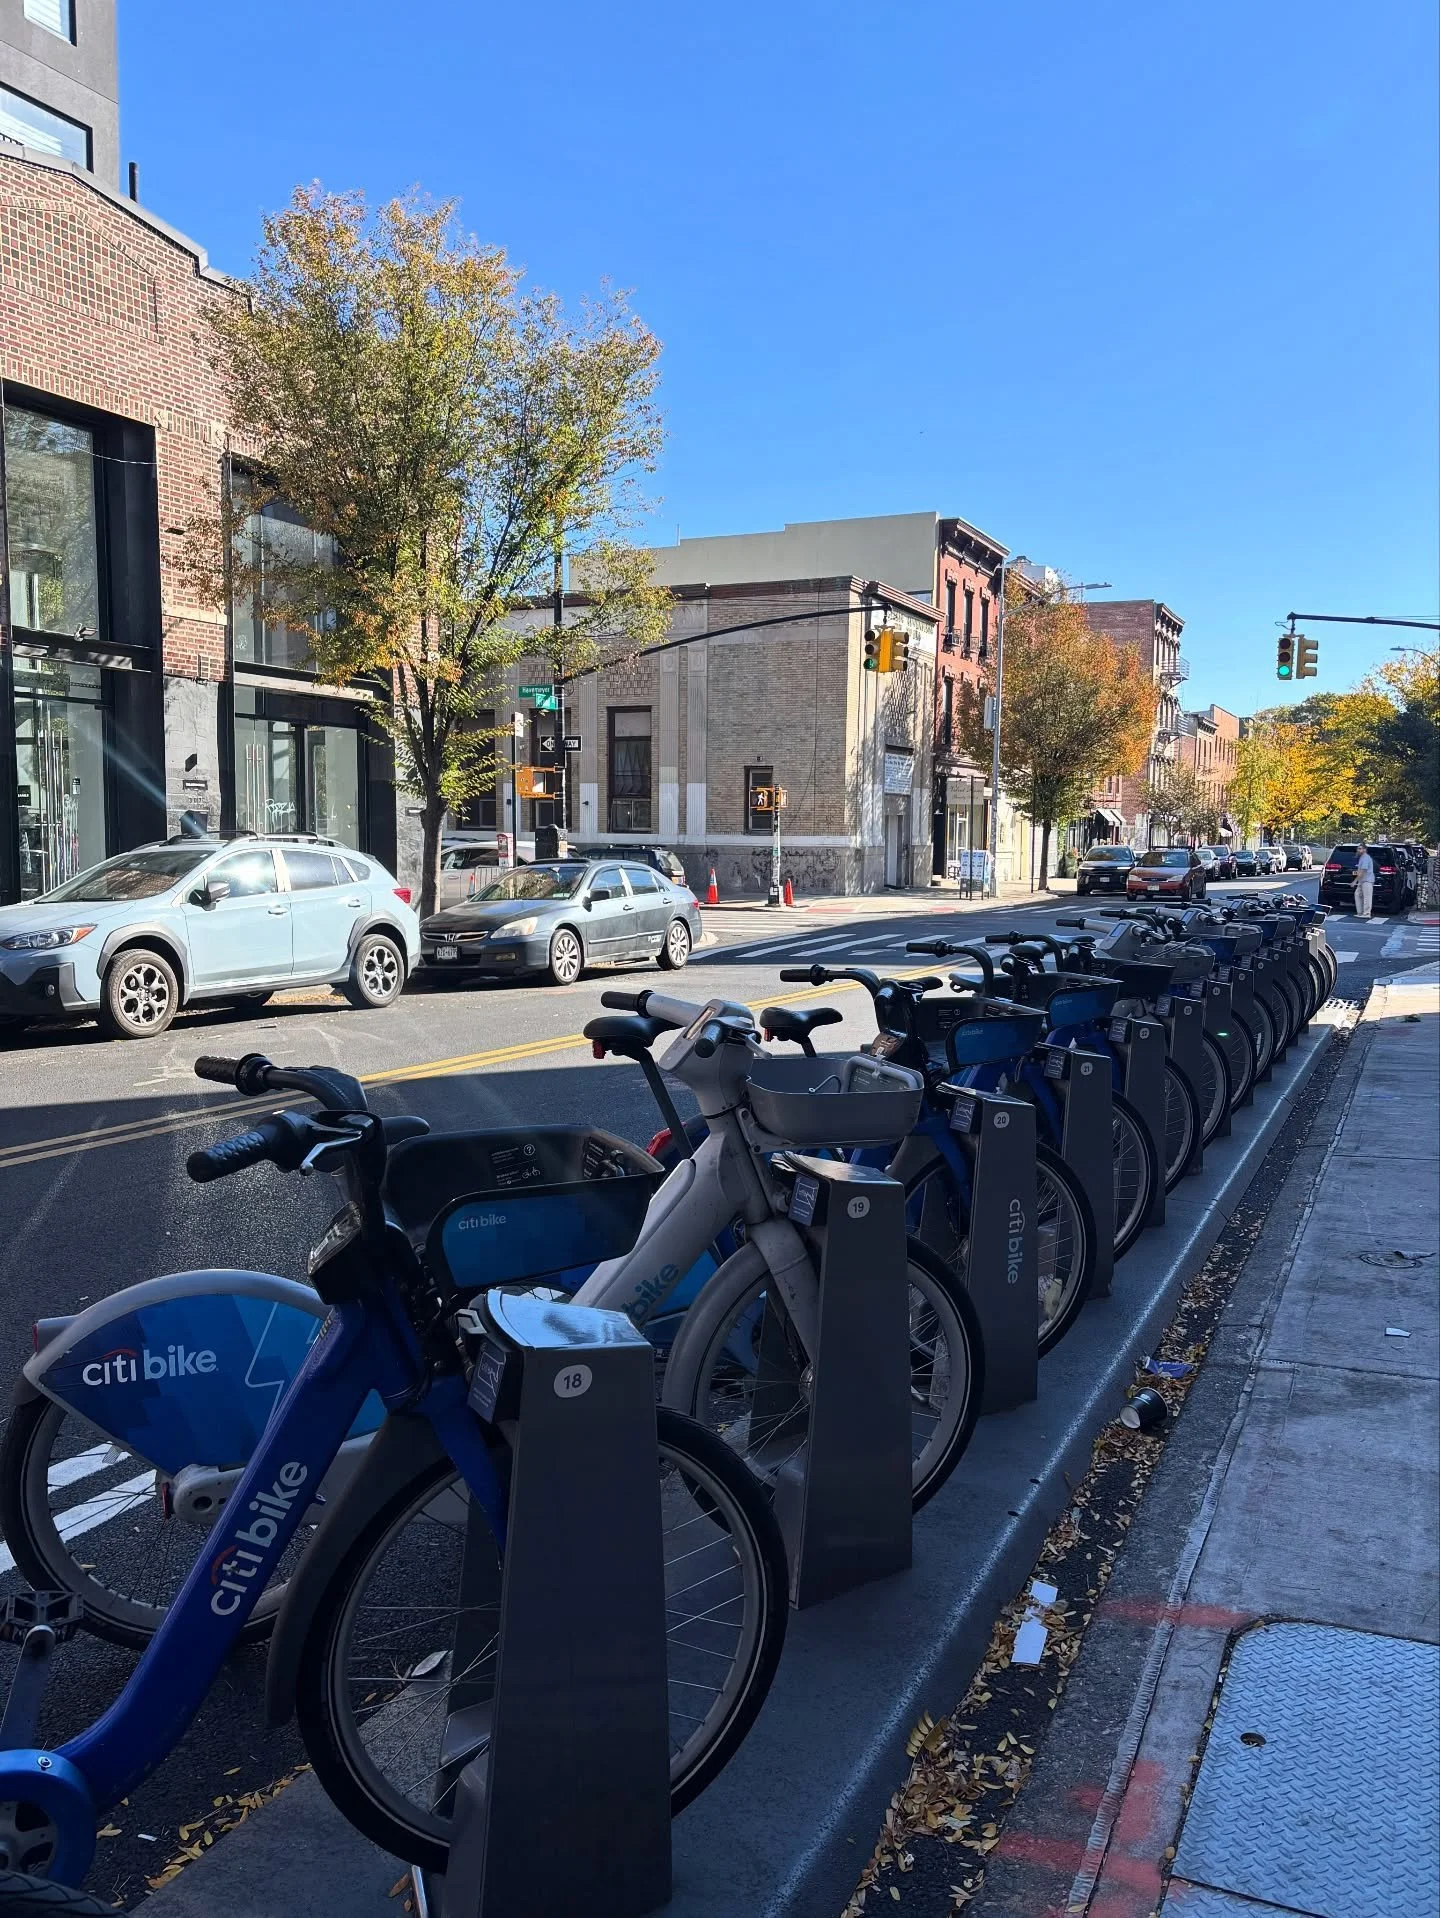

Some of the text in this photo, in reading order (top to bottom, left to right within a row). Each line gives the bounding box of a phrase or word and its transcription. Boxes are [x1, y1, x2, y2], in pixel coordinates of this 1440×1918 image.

[996, 1116, 1007, 1125] 20
[852, 1201, 864, 1214] 19
[479, 1214, 507, 1227] bike
[1007, 1236, 1023, 1285] bike
[143, 1345, 218, 1380] bike
[563, 1373, 582, 1390] 18
[234, 1461, 308, 1548] bike
